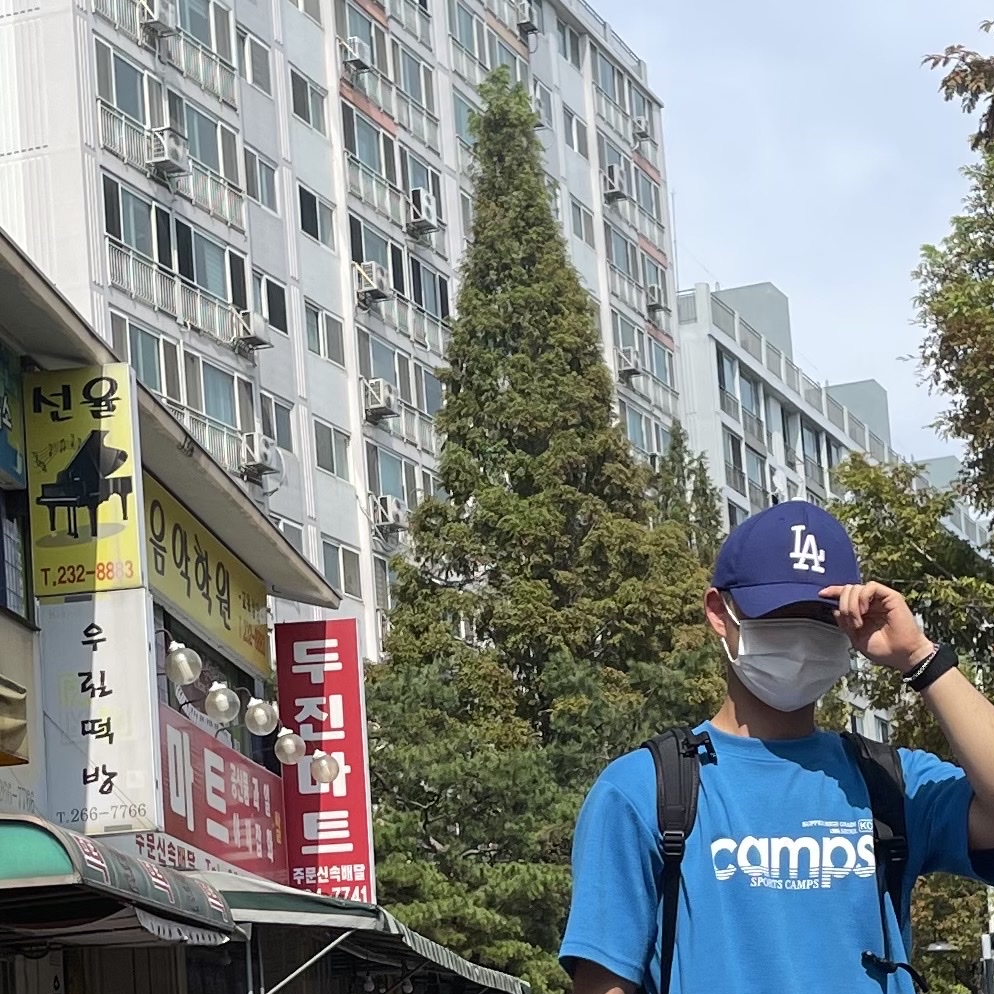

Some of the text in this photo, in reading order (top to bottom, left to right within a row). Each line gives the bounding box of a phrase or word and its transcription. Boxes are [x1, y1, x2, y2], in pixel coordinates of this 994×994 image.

[32, 376, 123, 423] 선율
[149, 499, 231, 630] 음악학원
[789, 524, 826, 574] LA
[78, 622, 118, 794] 우림떡방
[291, 638, 354, 855] 두진마트
[166, 724, 230, 844] 마트
[56, 803, 147, 825] T.266-7766
[293, 864, 365, 885] 주문신속배달
[711, 835, 876, 889] camps
[750, 877, 819, 890] SPORTS CAMPS
